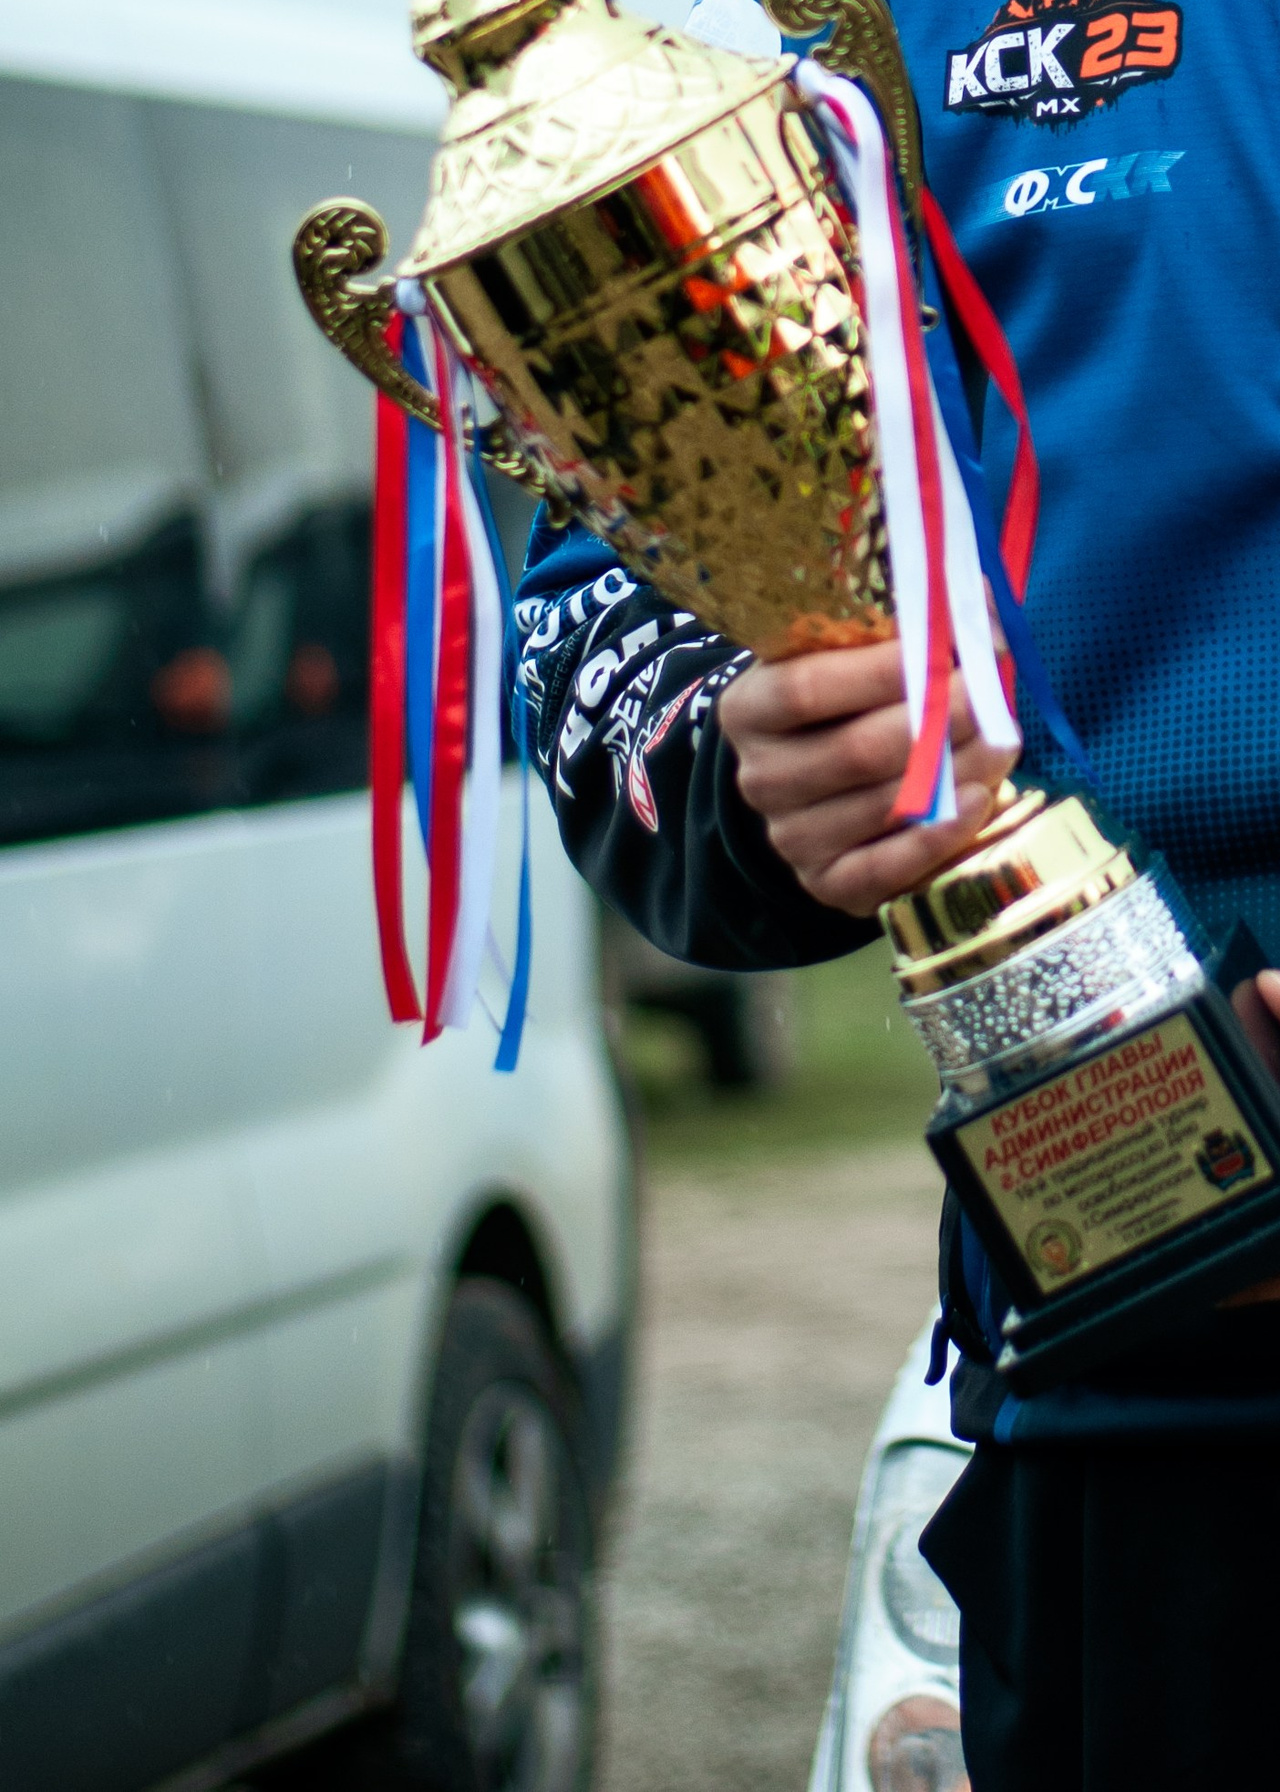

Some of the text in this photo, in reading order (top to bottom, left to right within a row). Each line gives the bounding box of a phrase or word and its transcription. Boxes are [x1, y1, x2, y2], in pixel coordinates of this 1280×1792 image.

[1079, 9, 1179, 78] 23
[1036, 97, 1081, 117] MX
[984, 1042, 1197, 1170] АДМИНИСТРАЦИИ
[990, 1033, 1163, 1136] КУБОК ГЛАВЫ
